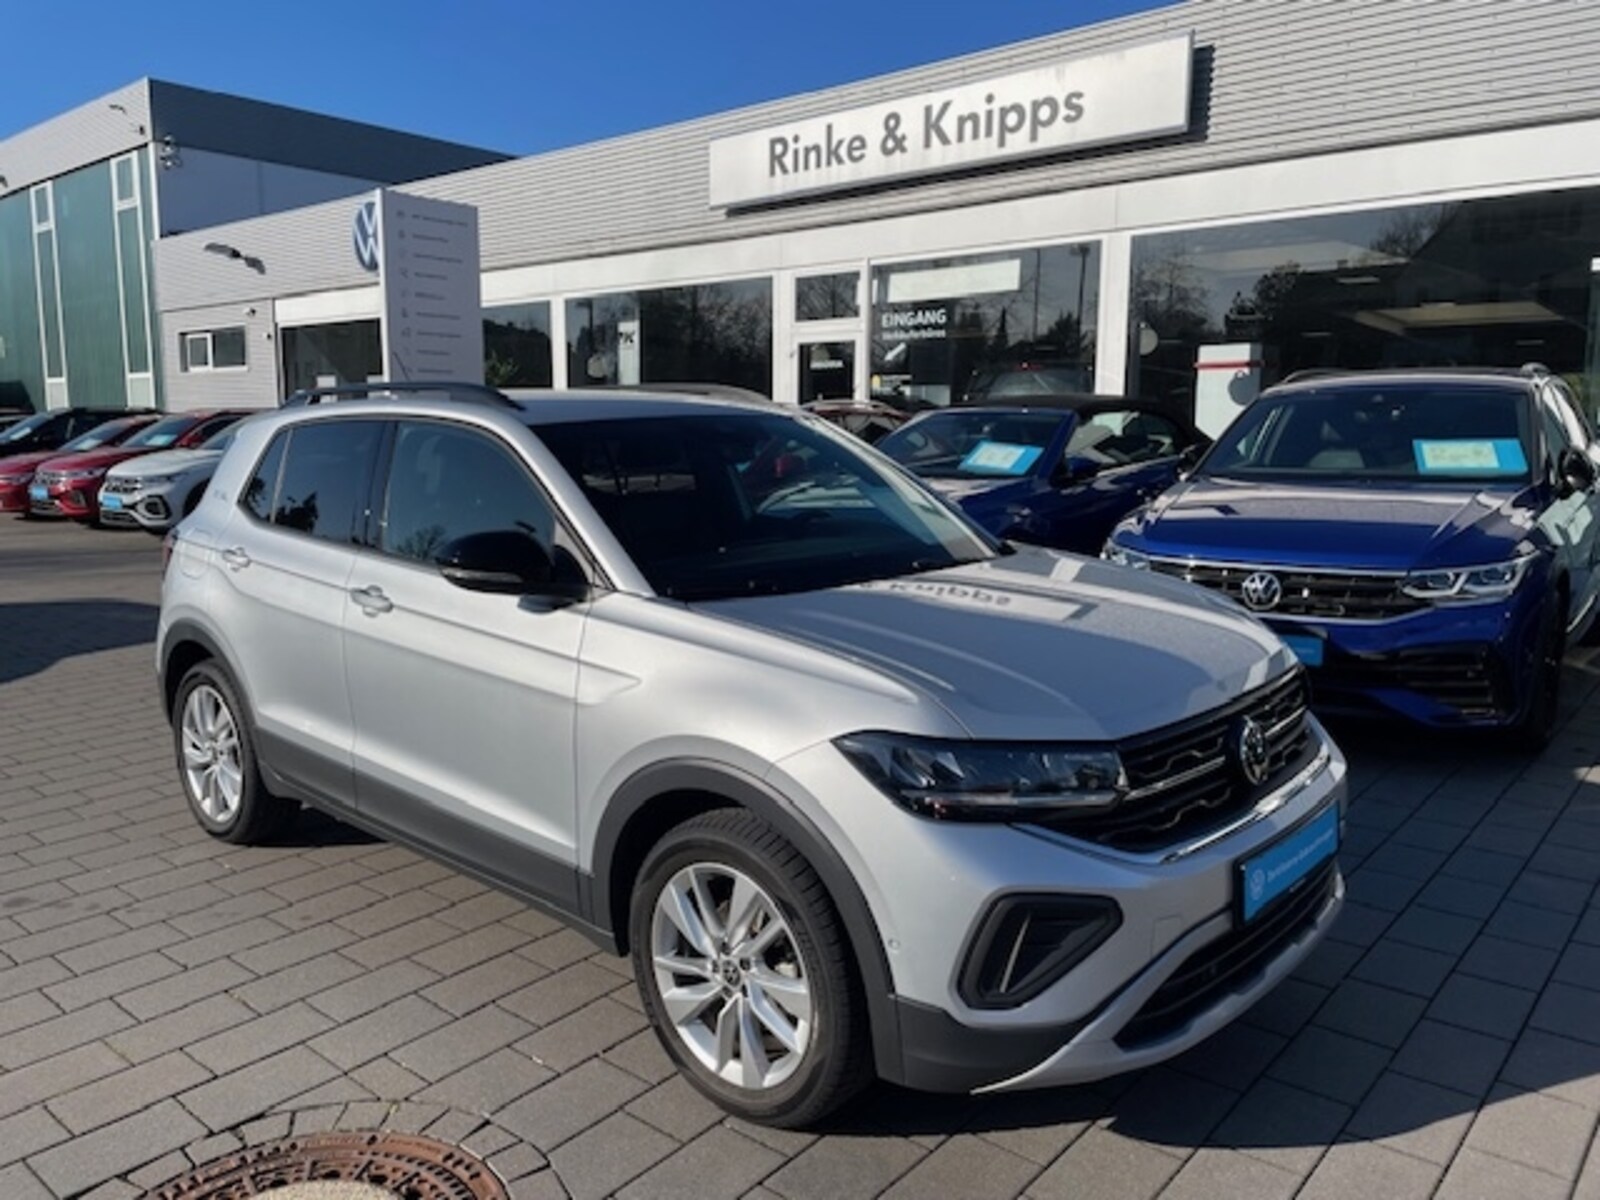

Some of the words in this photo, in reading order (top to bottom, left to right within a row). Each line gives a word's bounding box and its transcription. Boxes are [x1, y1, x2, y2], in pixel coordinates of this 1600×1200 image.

[769, 124, 866, 177] Rinke
[881, 112, 907, 155] &
[923, 91, 1084, 147] Knipps
[882, 309, 947, 328] EINGANG
